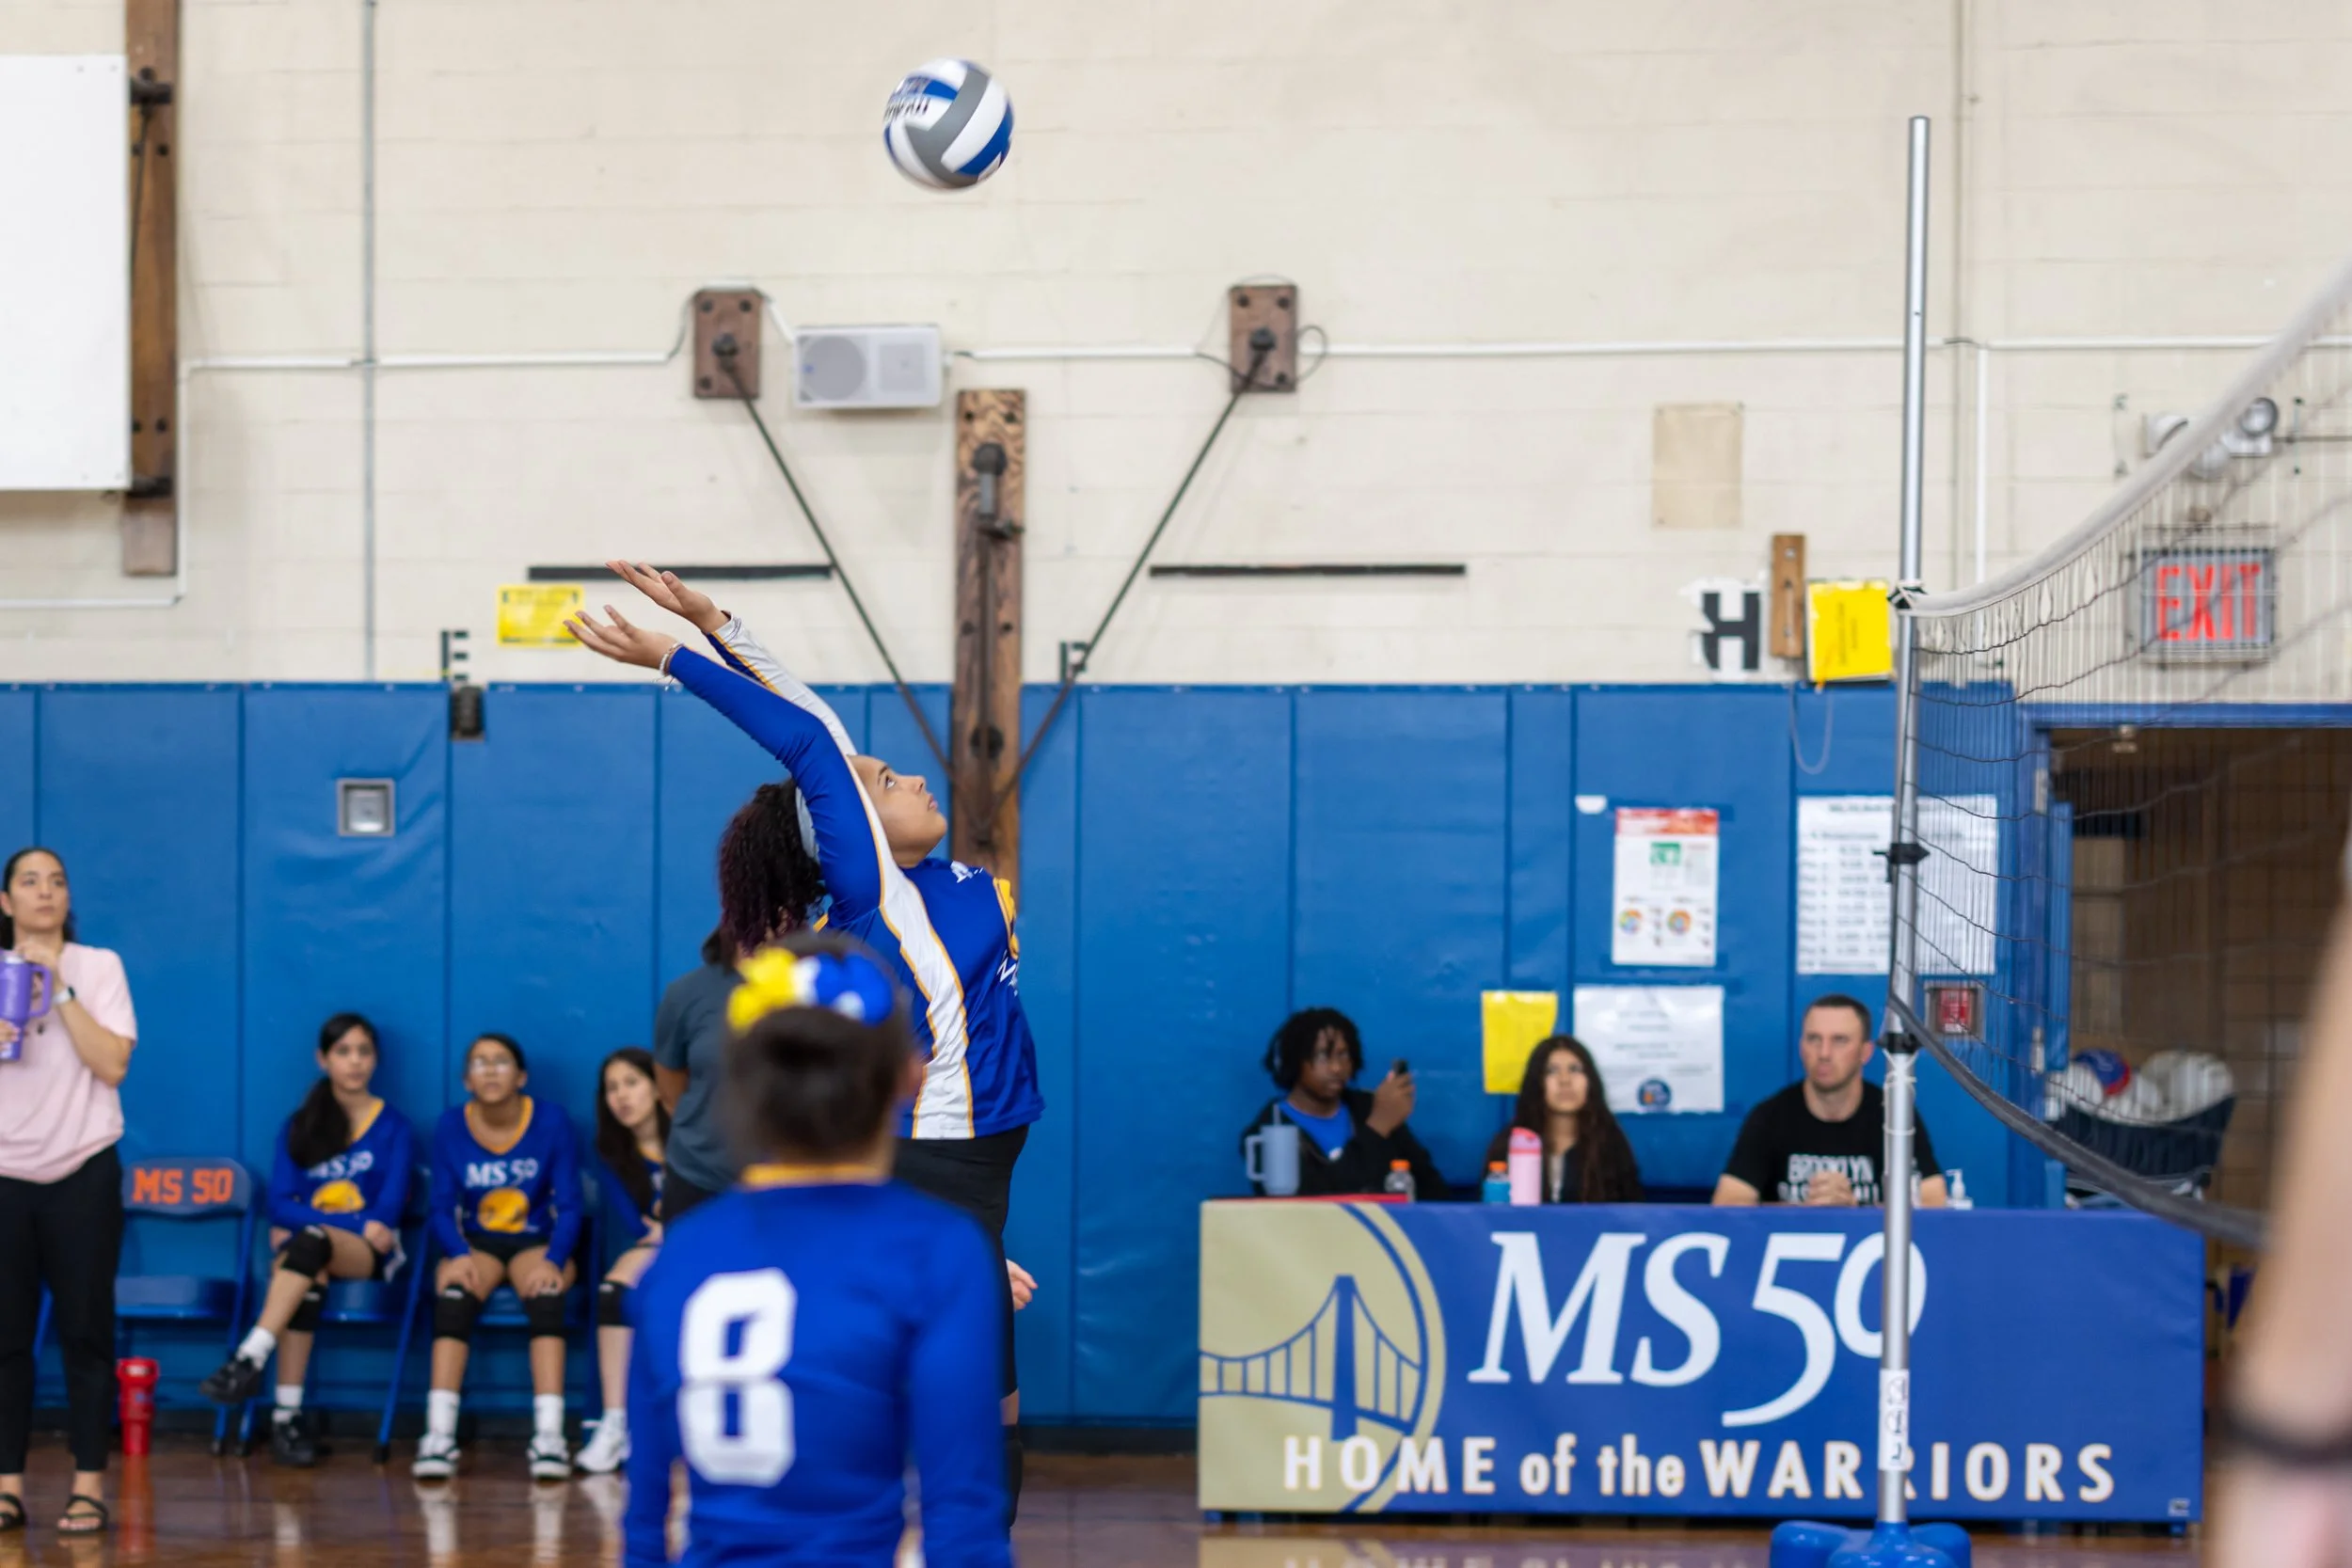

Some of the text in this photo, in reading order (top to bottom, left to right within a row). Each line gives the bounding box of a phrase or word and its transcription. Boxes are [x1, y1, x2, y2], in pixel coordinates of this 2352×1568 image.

[1701, 591, 1759, 670] H
[2155, 562, 2261, 641] EXIT
[441, 630, 469, 681] E
[132, 1167, 234, 1205] MS 50
[1467, 1231, 1731, 1387] MS
[1722, 1230, 1928, 1427] 50
[677, 1267, 798, 1488] 8
[1283, 1435, 1497, 1494] HOME
[1519, 1433, 1578, 1496] of
[1597, 1433, 1686, 1497] the
